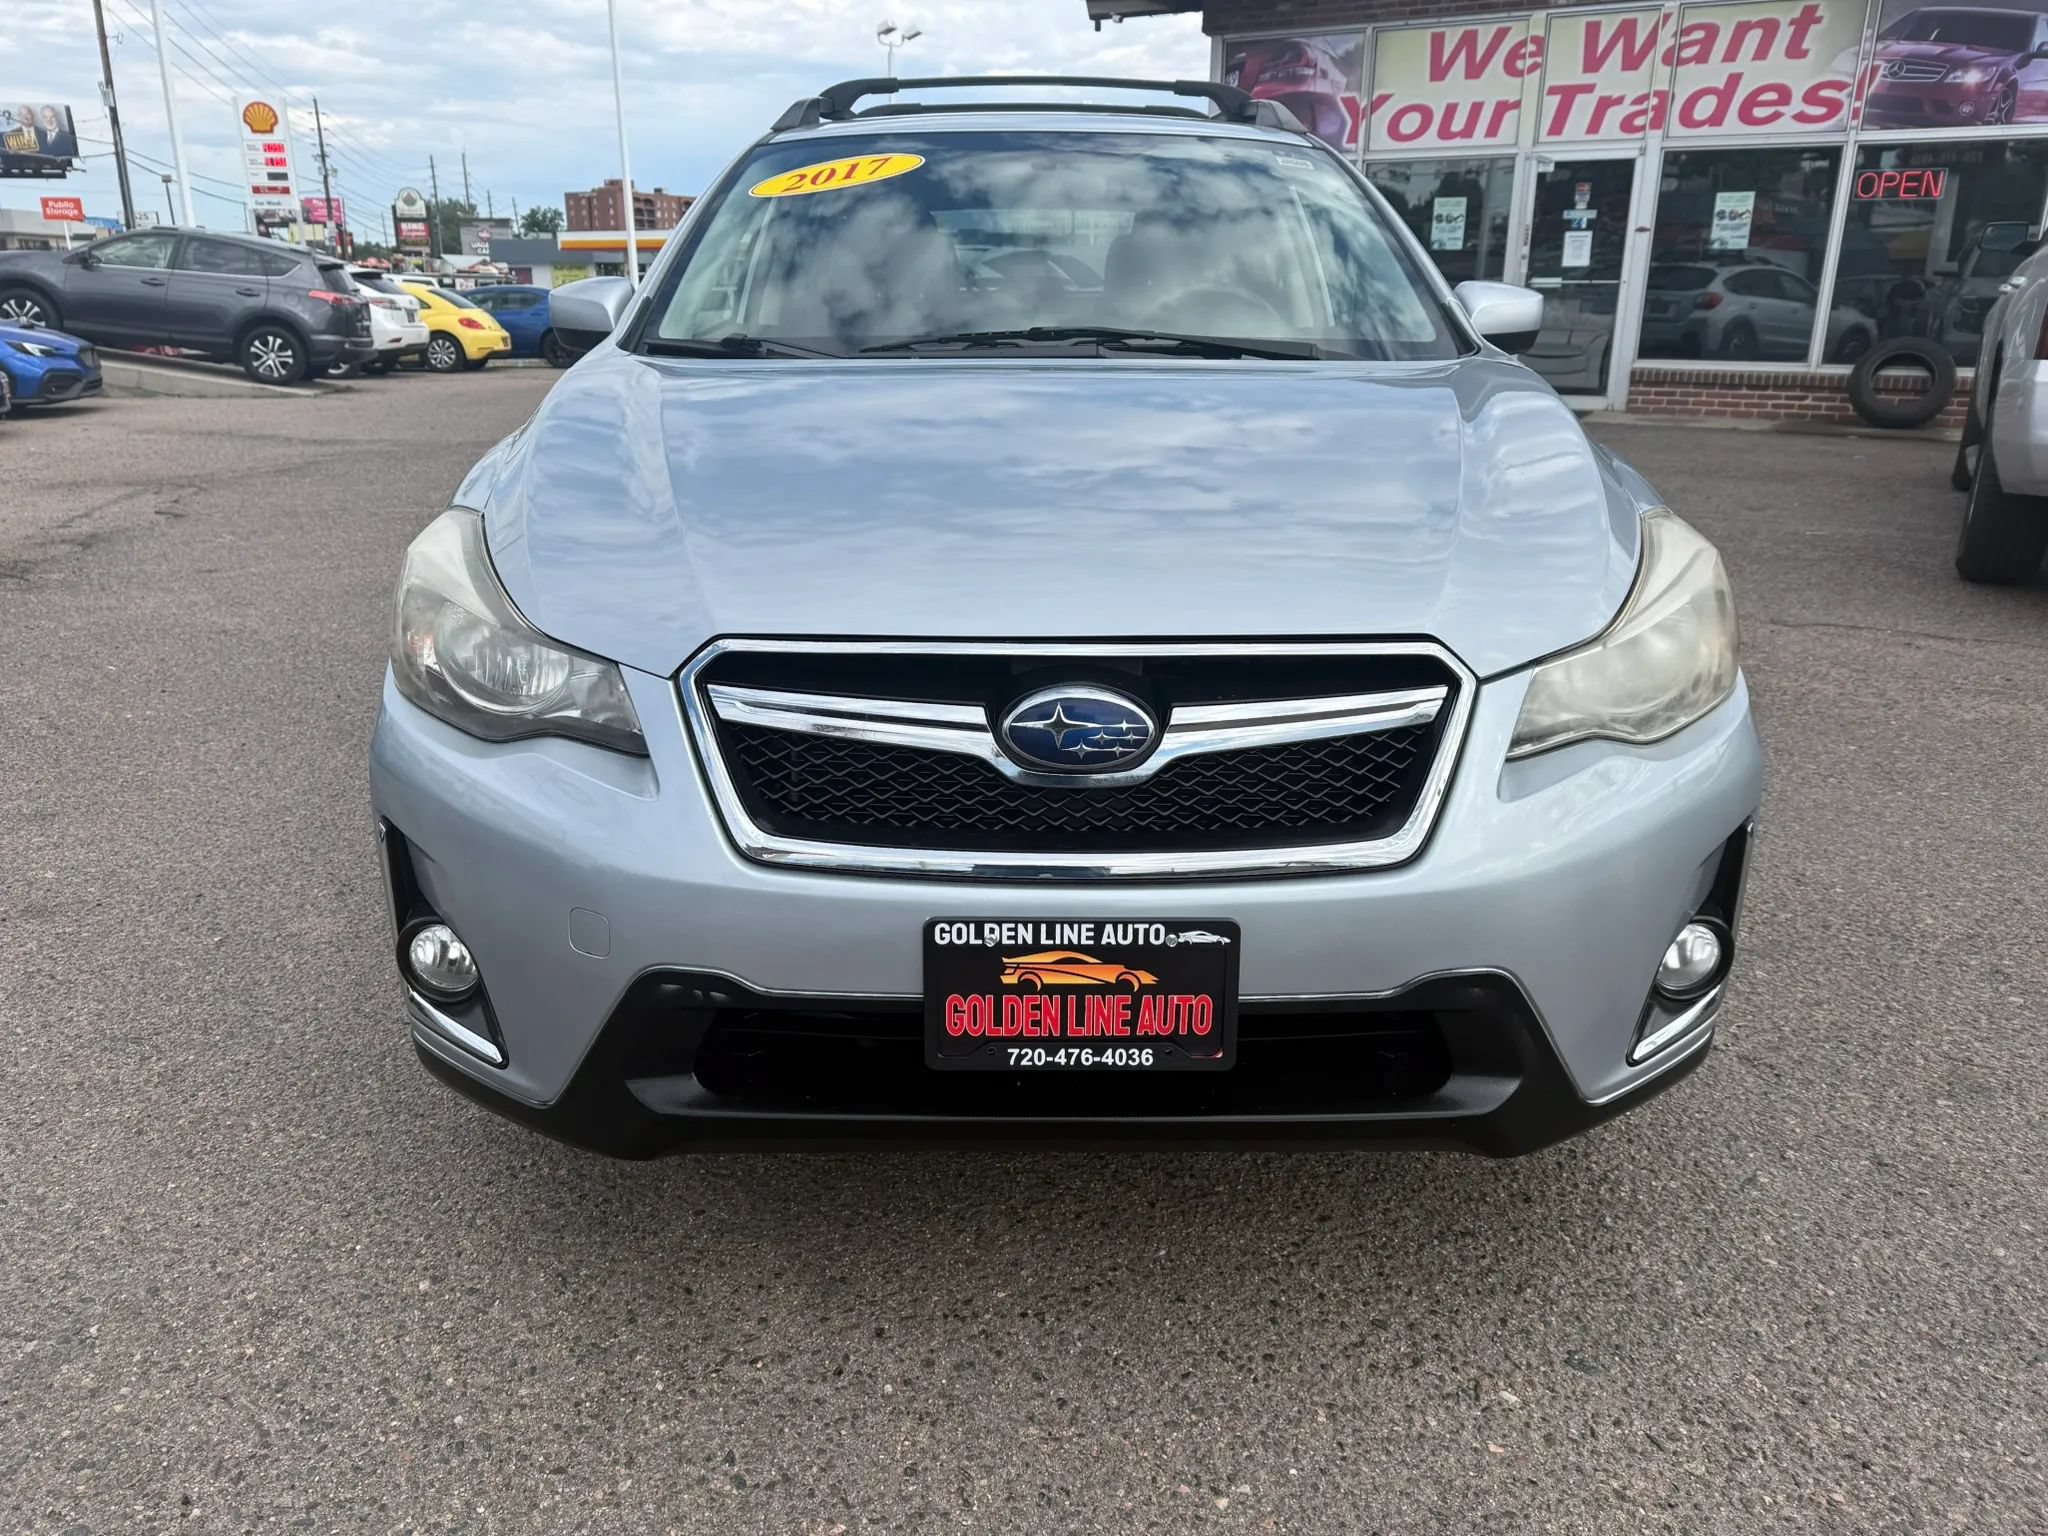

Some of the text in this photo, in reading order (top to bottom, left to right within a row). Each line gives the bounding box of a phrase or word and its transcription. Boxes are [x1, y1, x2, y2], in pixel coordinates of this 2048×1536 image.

[1429, 4, 1824, 82] We Want
[1340, 63, 1881, 144] Your Trades!
[781, 156, 893, 193] 2017
[1857, 170, 1945, 199] OPEN
[45, 207, 79, 217] Storage
[47, 200, 74, 208] Public
[934, 923, 1166, 945] GOLDEN LINE AUTO
[945, 994, 1213, 1037] GOLDEN LINE AUTO
[1007, 1048, 1154, 1066] 720-476-4036
